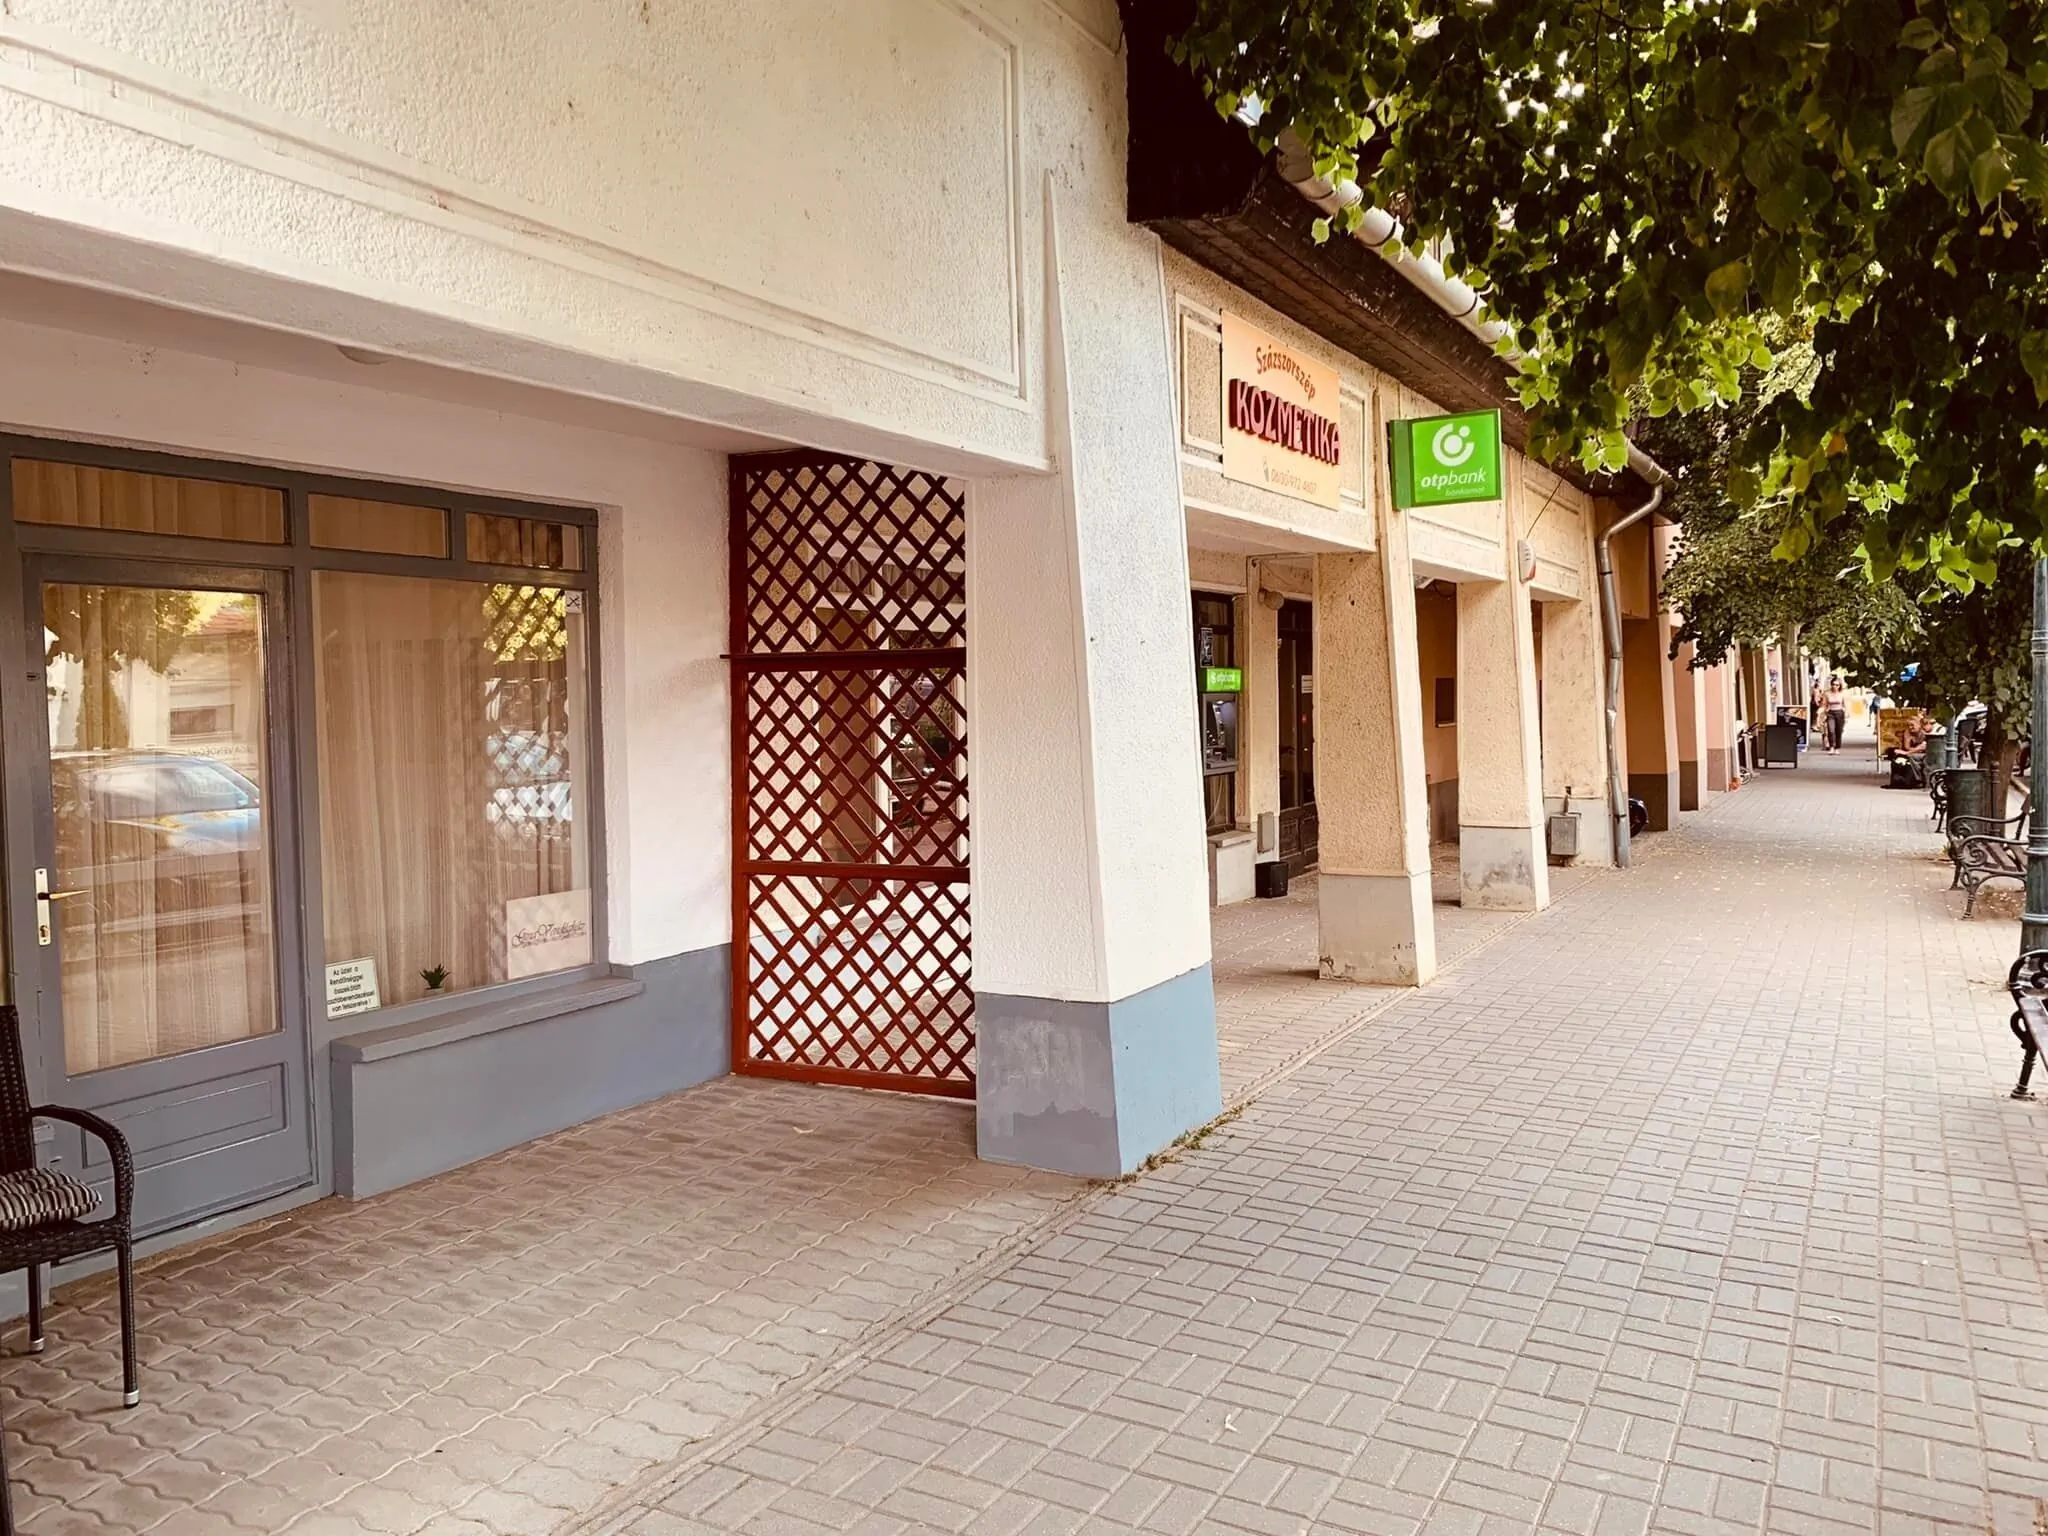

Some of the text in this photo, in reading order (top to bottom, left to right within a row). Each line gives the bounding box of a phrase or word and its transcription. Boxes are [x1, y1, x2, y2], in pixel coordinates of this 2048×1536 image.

[1256, 343, 1316, 402] Százszorszép
[1230, 378, 1341, 467] KOZMETIKA
[1421, 467, 1487, 490] otpbank
